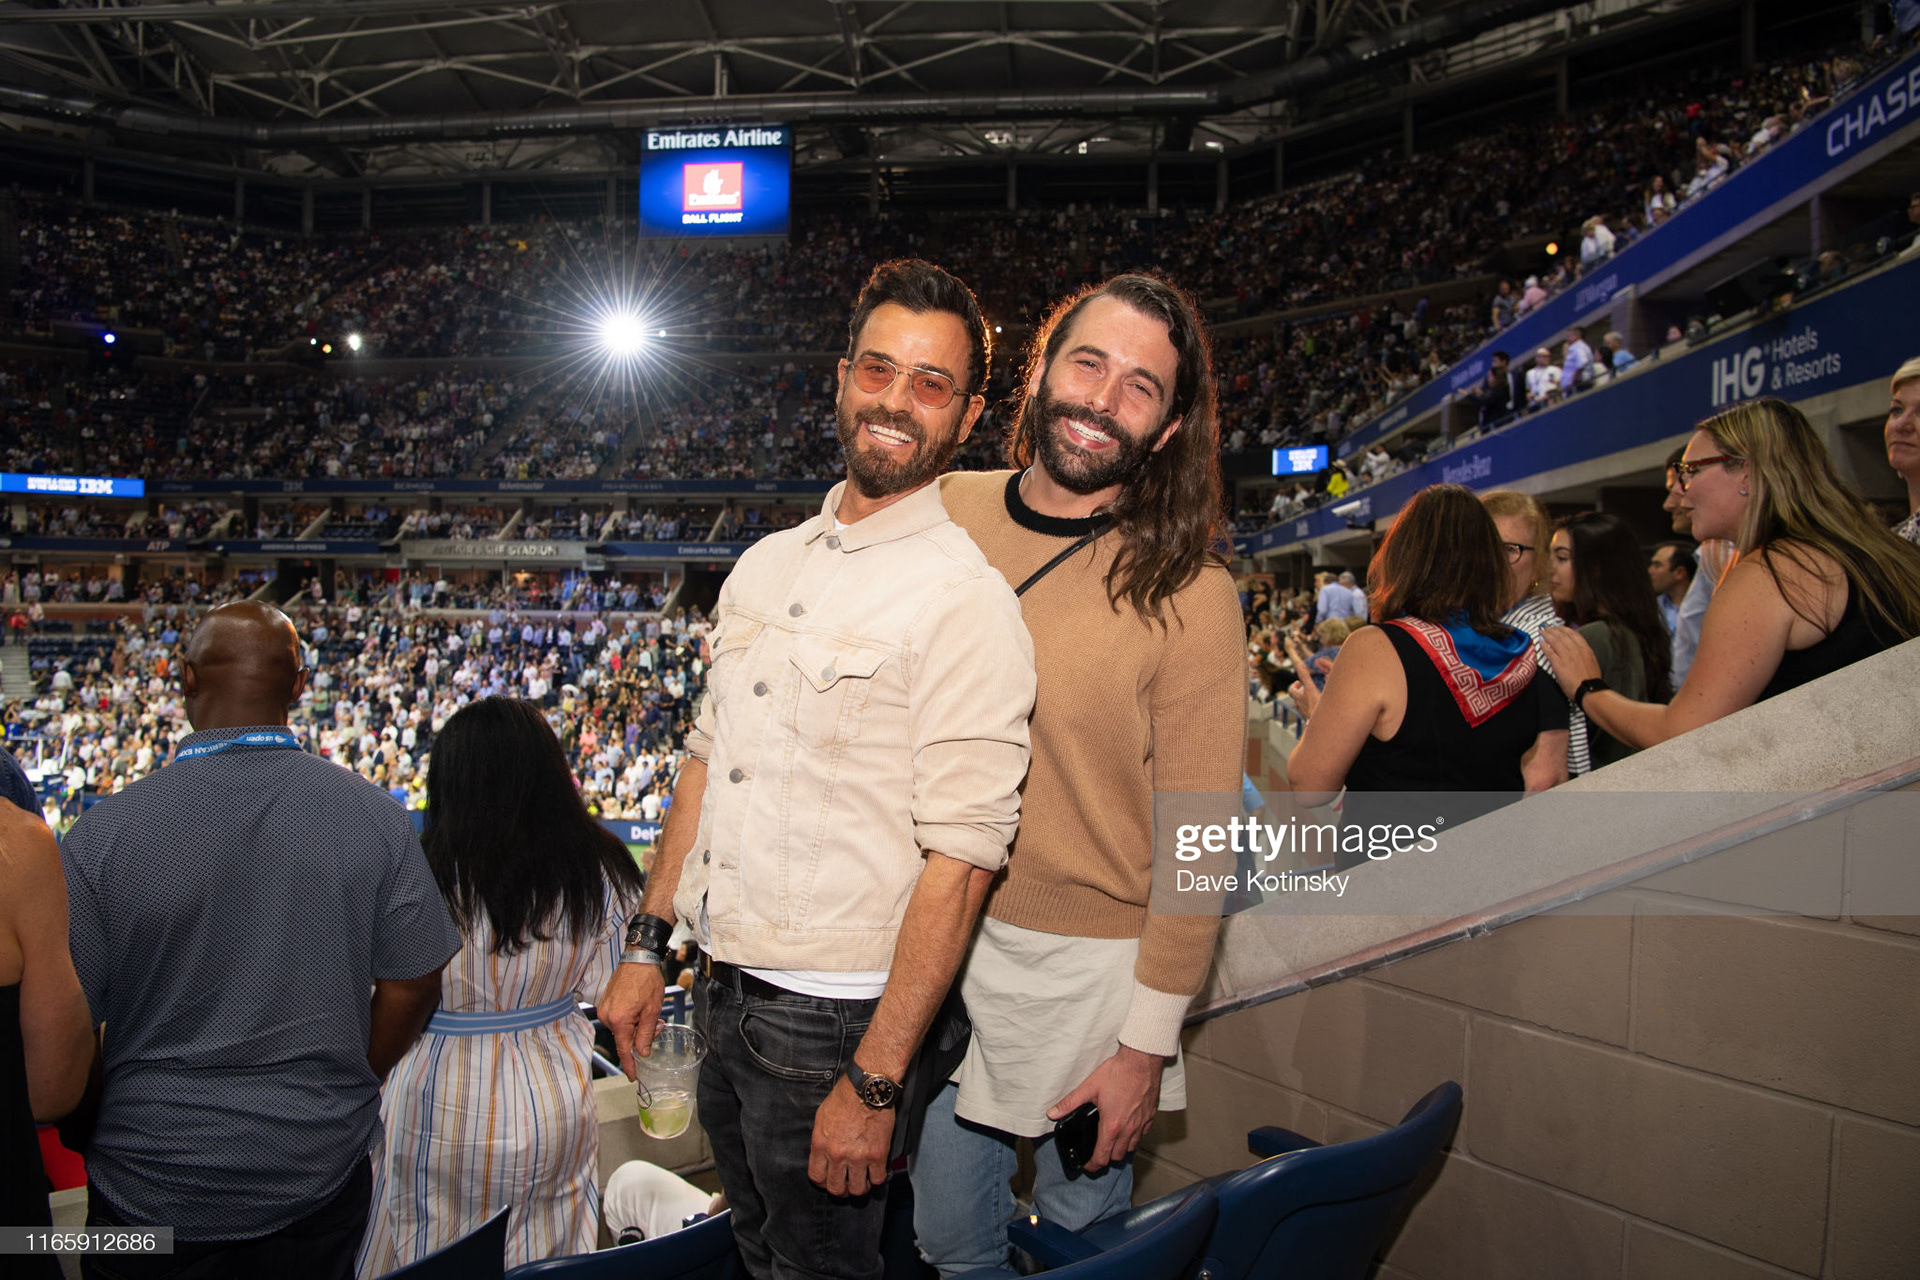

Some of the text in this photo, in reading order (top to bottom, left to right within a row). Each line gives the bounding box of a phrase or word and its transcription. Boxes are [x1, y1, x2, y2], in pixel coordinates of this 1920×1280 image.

[1826, 65, 1920, 157] CHASE
[647, 128, 782, 150] Emirates Airline
[682, 213, 708, 224] BALL
[1771, 325, 1819, 363] Hotels
[1711, 346, 1766, 407] IHG
[1770, 352, 1841, 390] & Resorts
[79, 478, 113, 494] IBM
[630, 826, 655, 841] Del
